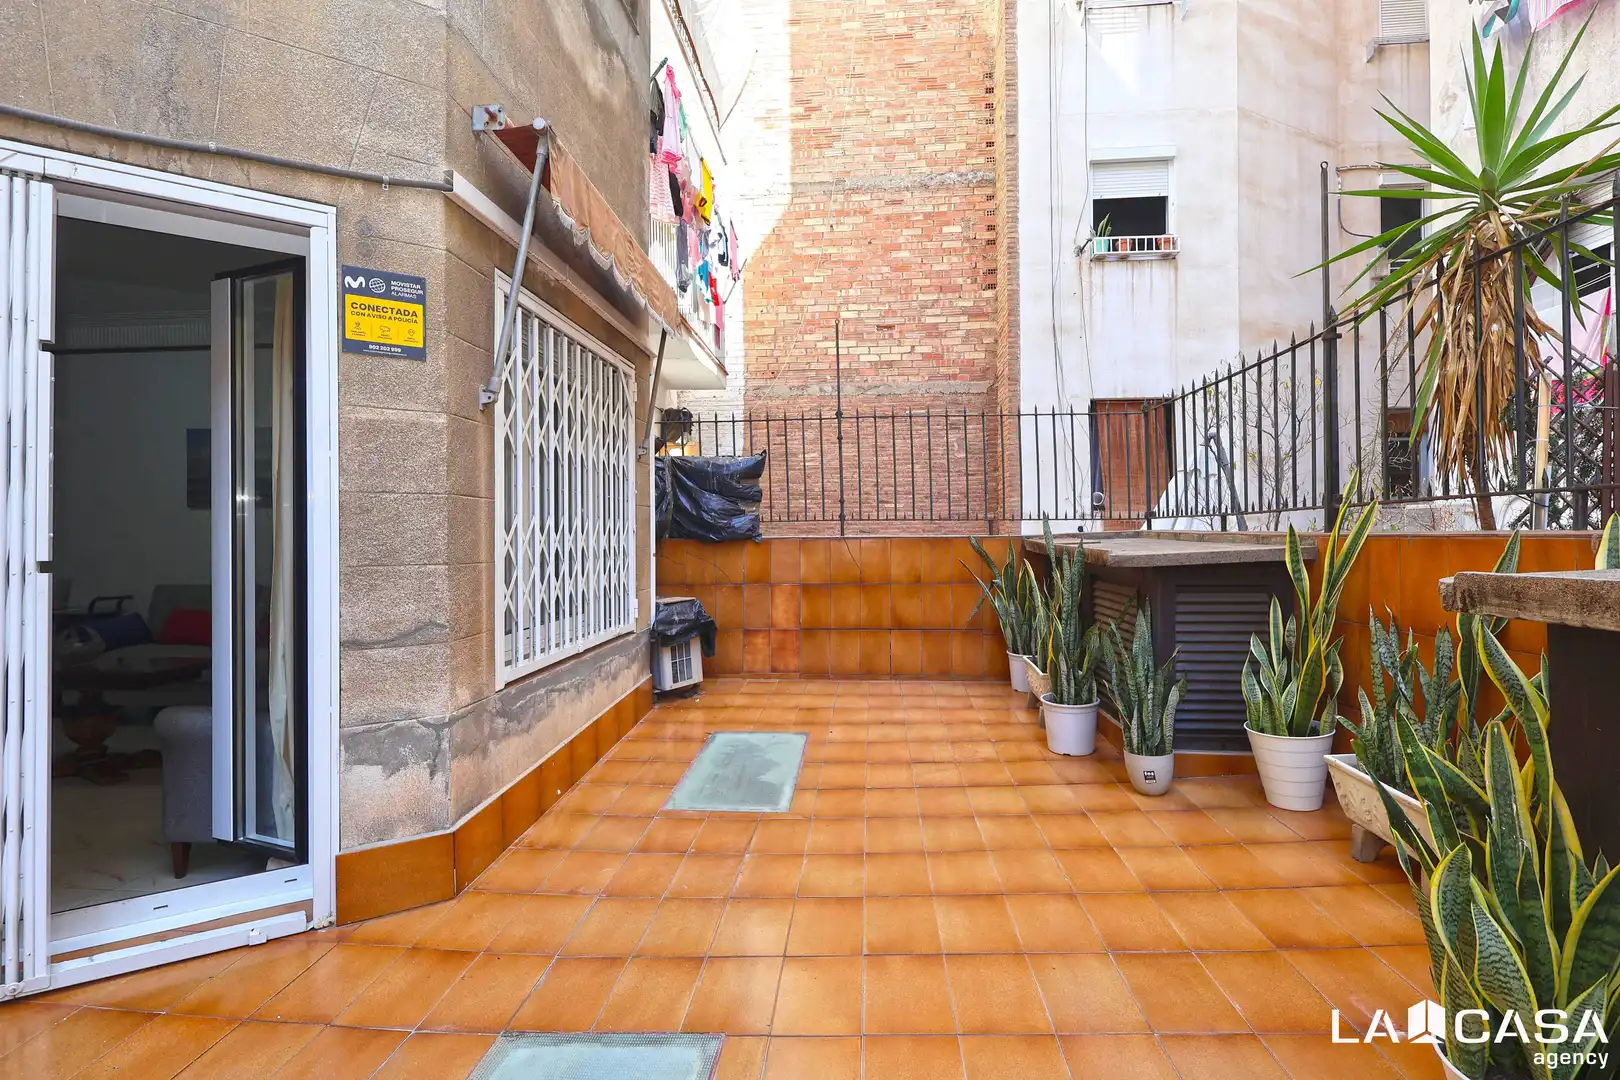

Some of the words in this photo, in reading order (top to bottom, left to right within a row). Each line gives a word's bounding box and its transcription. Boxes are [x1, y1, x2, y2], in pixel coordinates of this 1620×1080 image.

[391, 280, 421, 289] MOVISTAR
[391, 286, 423, 295] PROSEGUR
[391, 291, 417, 299] ALARMAS
[350, 302, 418, 318] CONECTADA
